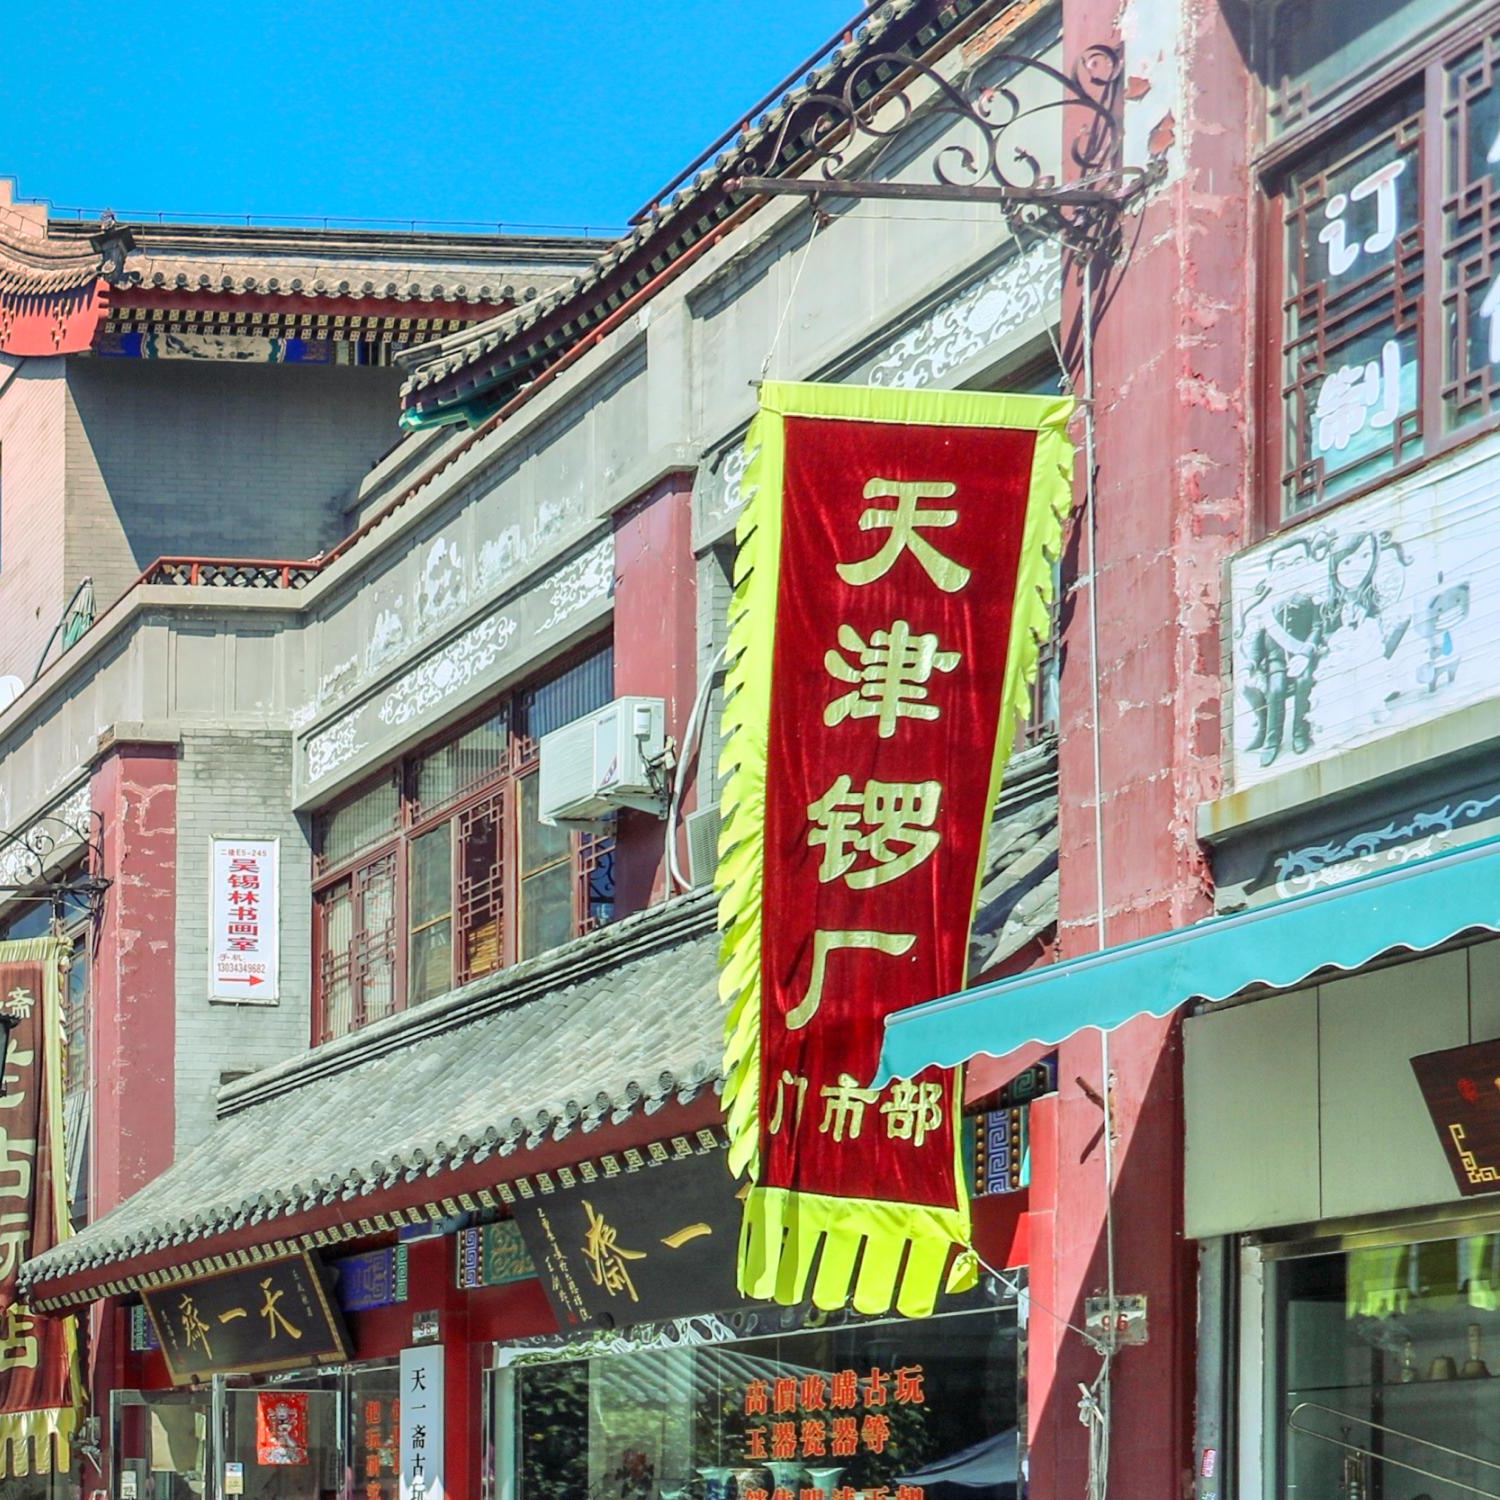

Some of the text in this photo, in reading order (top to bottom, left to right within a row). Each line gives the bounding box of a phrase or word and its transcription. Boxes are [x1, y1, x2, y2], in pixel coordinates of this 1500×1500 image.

[786, 477, 971, 1031] 天津锣厂
[227, 858, 260, 952] 吴锡林书画室
[769, 1070, 942, 1147] 门市部
[1102, 1313, 1129, 1331] 96
[744, 1364, 924, 1416] 高價收購古玩
[744, 1414, 890, 1460] 玉器瓷器等
